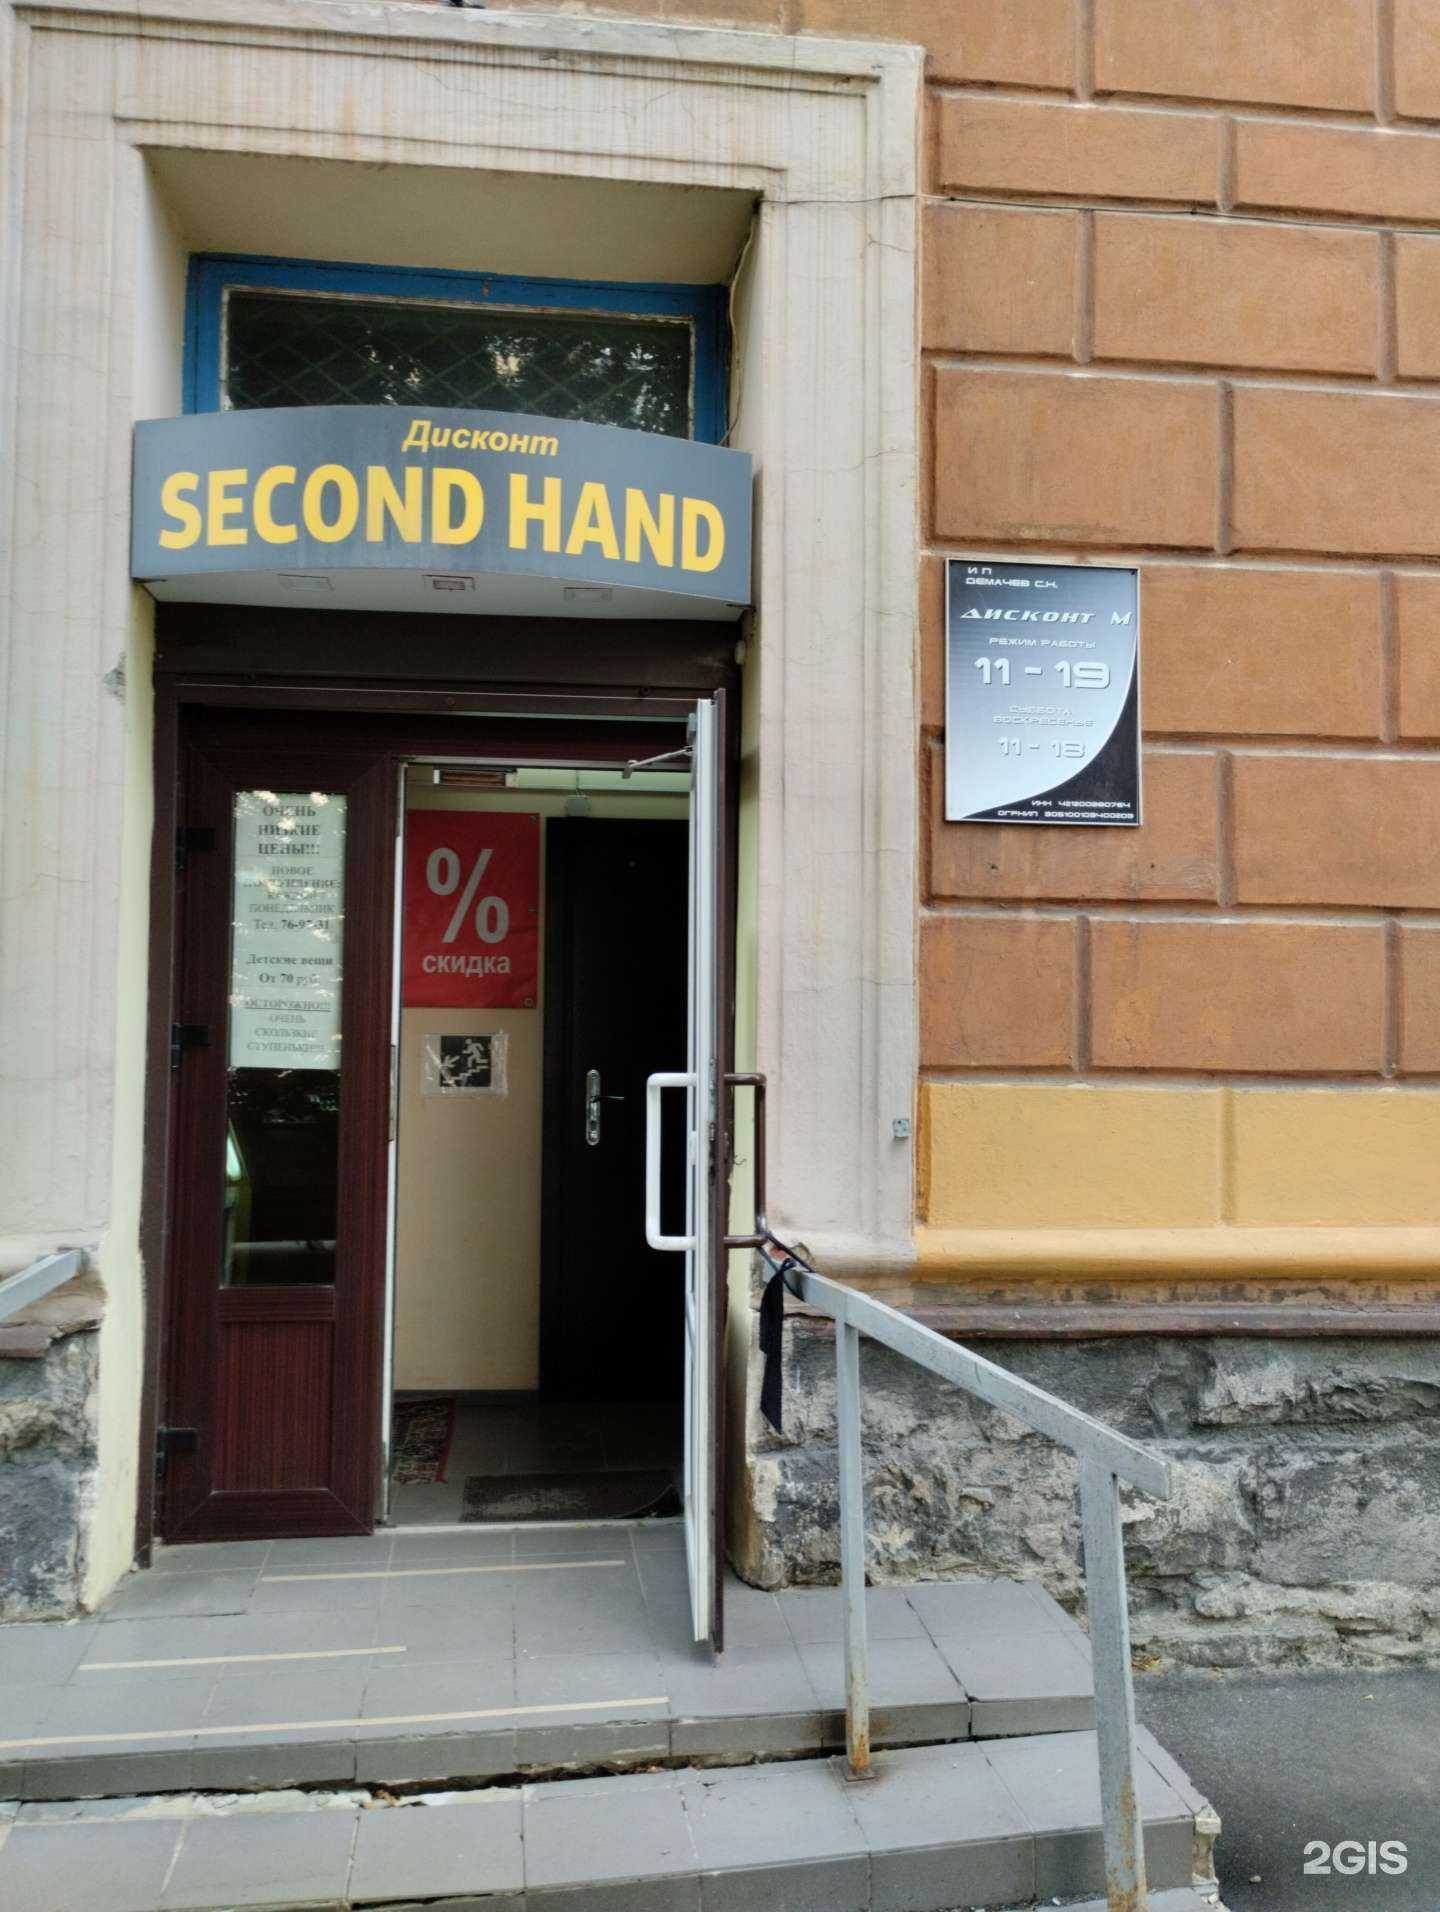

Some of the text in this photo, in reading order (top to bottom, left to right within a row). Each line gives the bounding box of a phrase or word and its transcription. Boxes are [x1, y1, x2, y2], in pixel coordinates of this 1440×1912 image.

[401, 419, 560, 457] Дисконт
[158, 463, 726, 573] SECOND HAND
[960, 608, 1132, 626] ДИСКОНТ М
[988, 636, 1096, 649] РЕЖИМ РАБОТЫ
[974, 656, 1010, 686] 11
[1053, 660, 1110, 690] 19
[998, 736, 1023, 757] 11
[422, 954, 512, 977] скидка
[259, 972, 276, 984] От
[280, 973, 294, 984] 70
